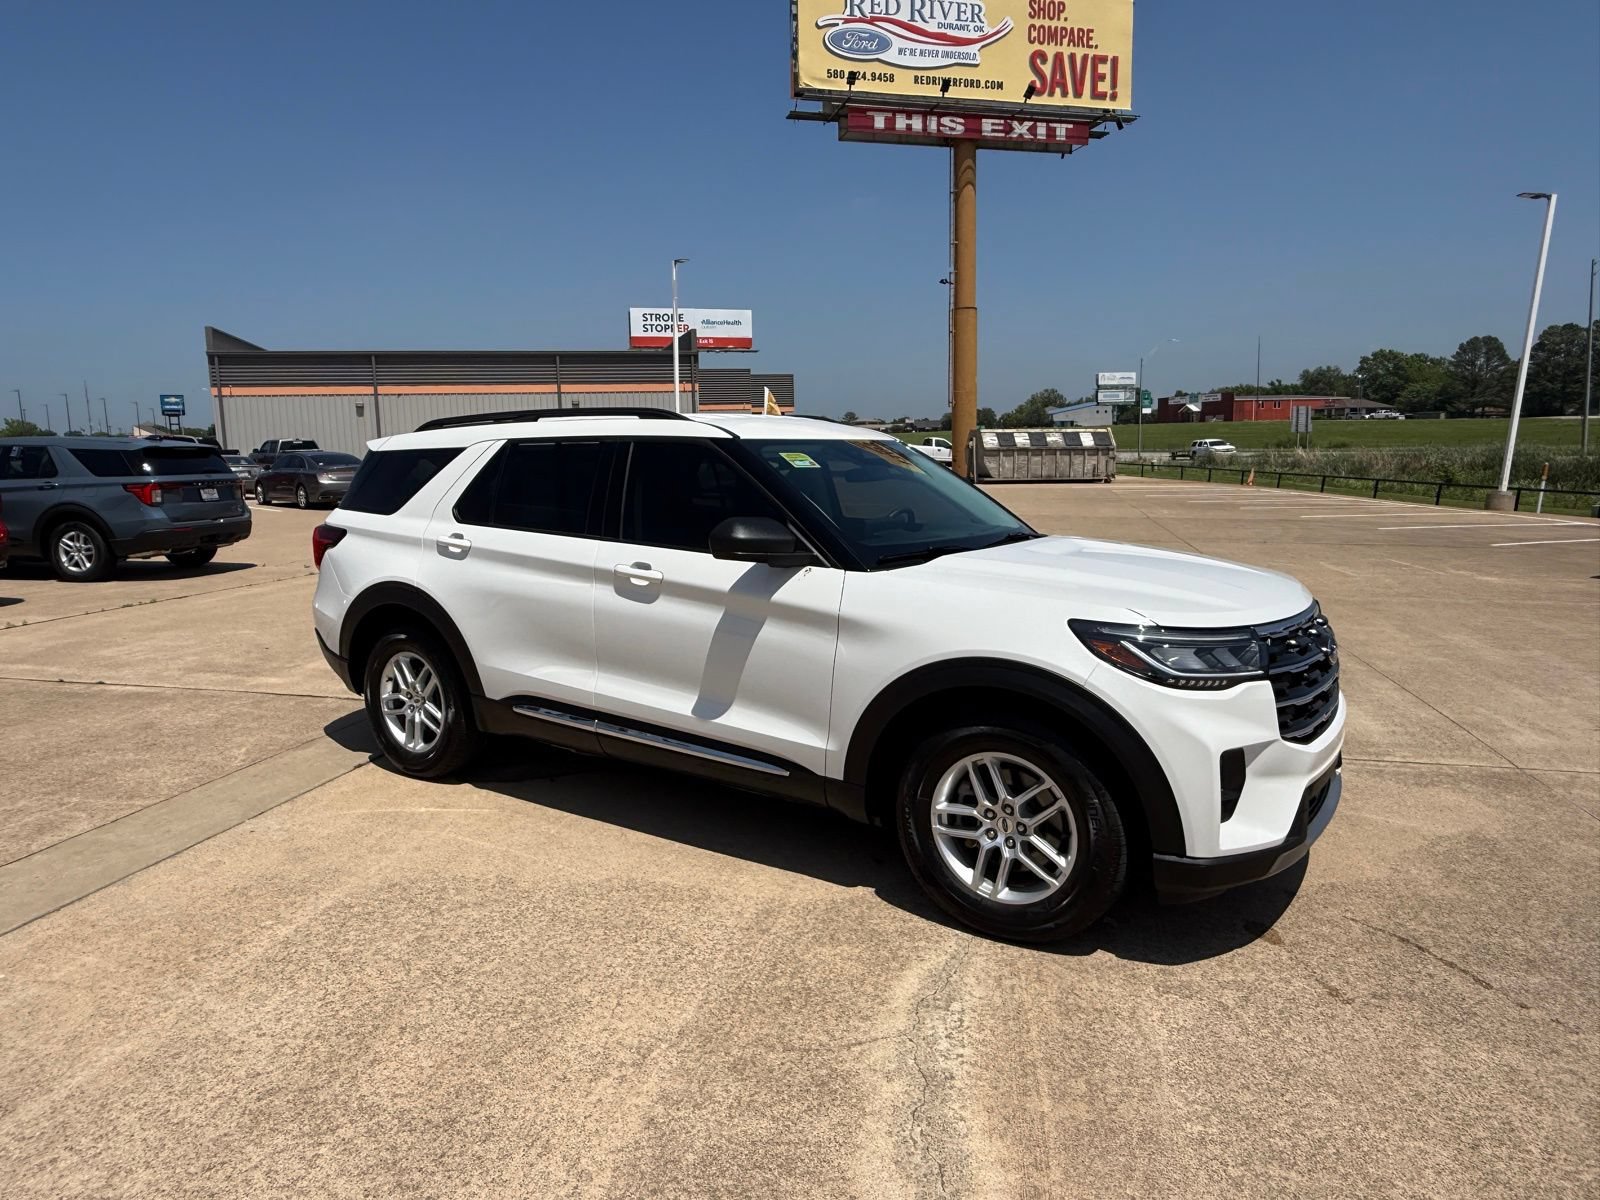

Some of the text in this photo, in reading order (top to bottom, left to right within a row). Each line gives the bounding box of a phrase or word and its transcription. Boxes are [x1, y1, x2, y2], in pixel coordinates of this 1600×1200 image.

[846, 0, 985, 25] RED RIVER
[1028, 0, 1068, 22] SHOP.
[937, 22, 985, 33] DURANT, OK
[1027, 23, 1099, 50] COMPARE.
[842, 31, 879, 50] Ford
[897, 47, 978, 61] WE'RE NEVER UNDERSOLD.
[826, 69, 895, 83] 580.24.9458
[1029, 48, 1119, 102] SAVE!
[866, 111, 1074, 141] THIS EXIT
